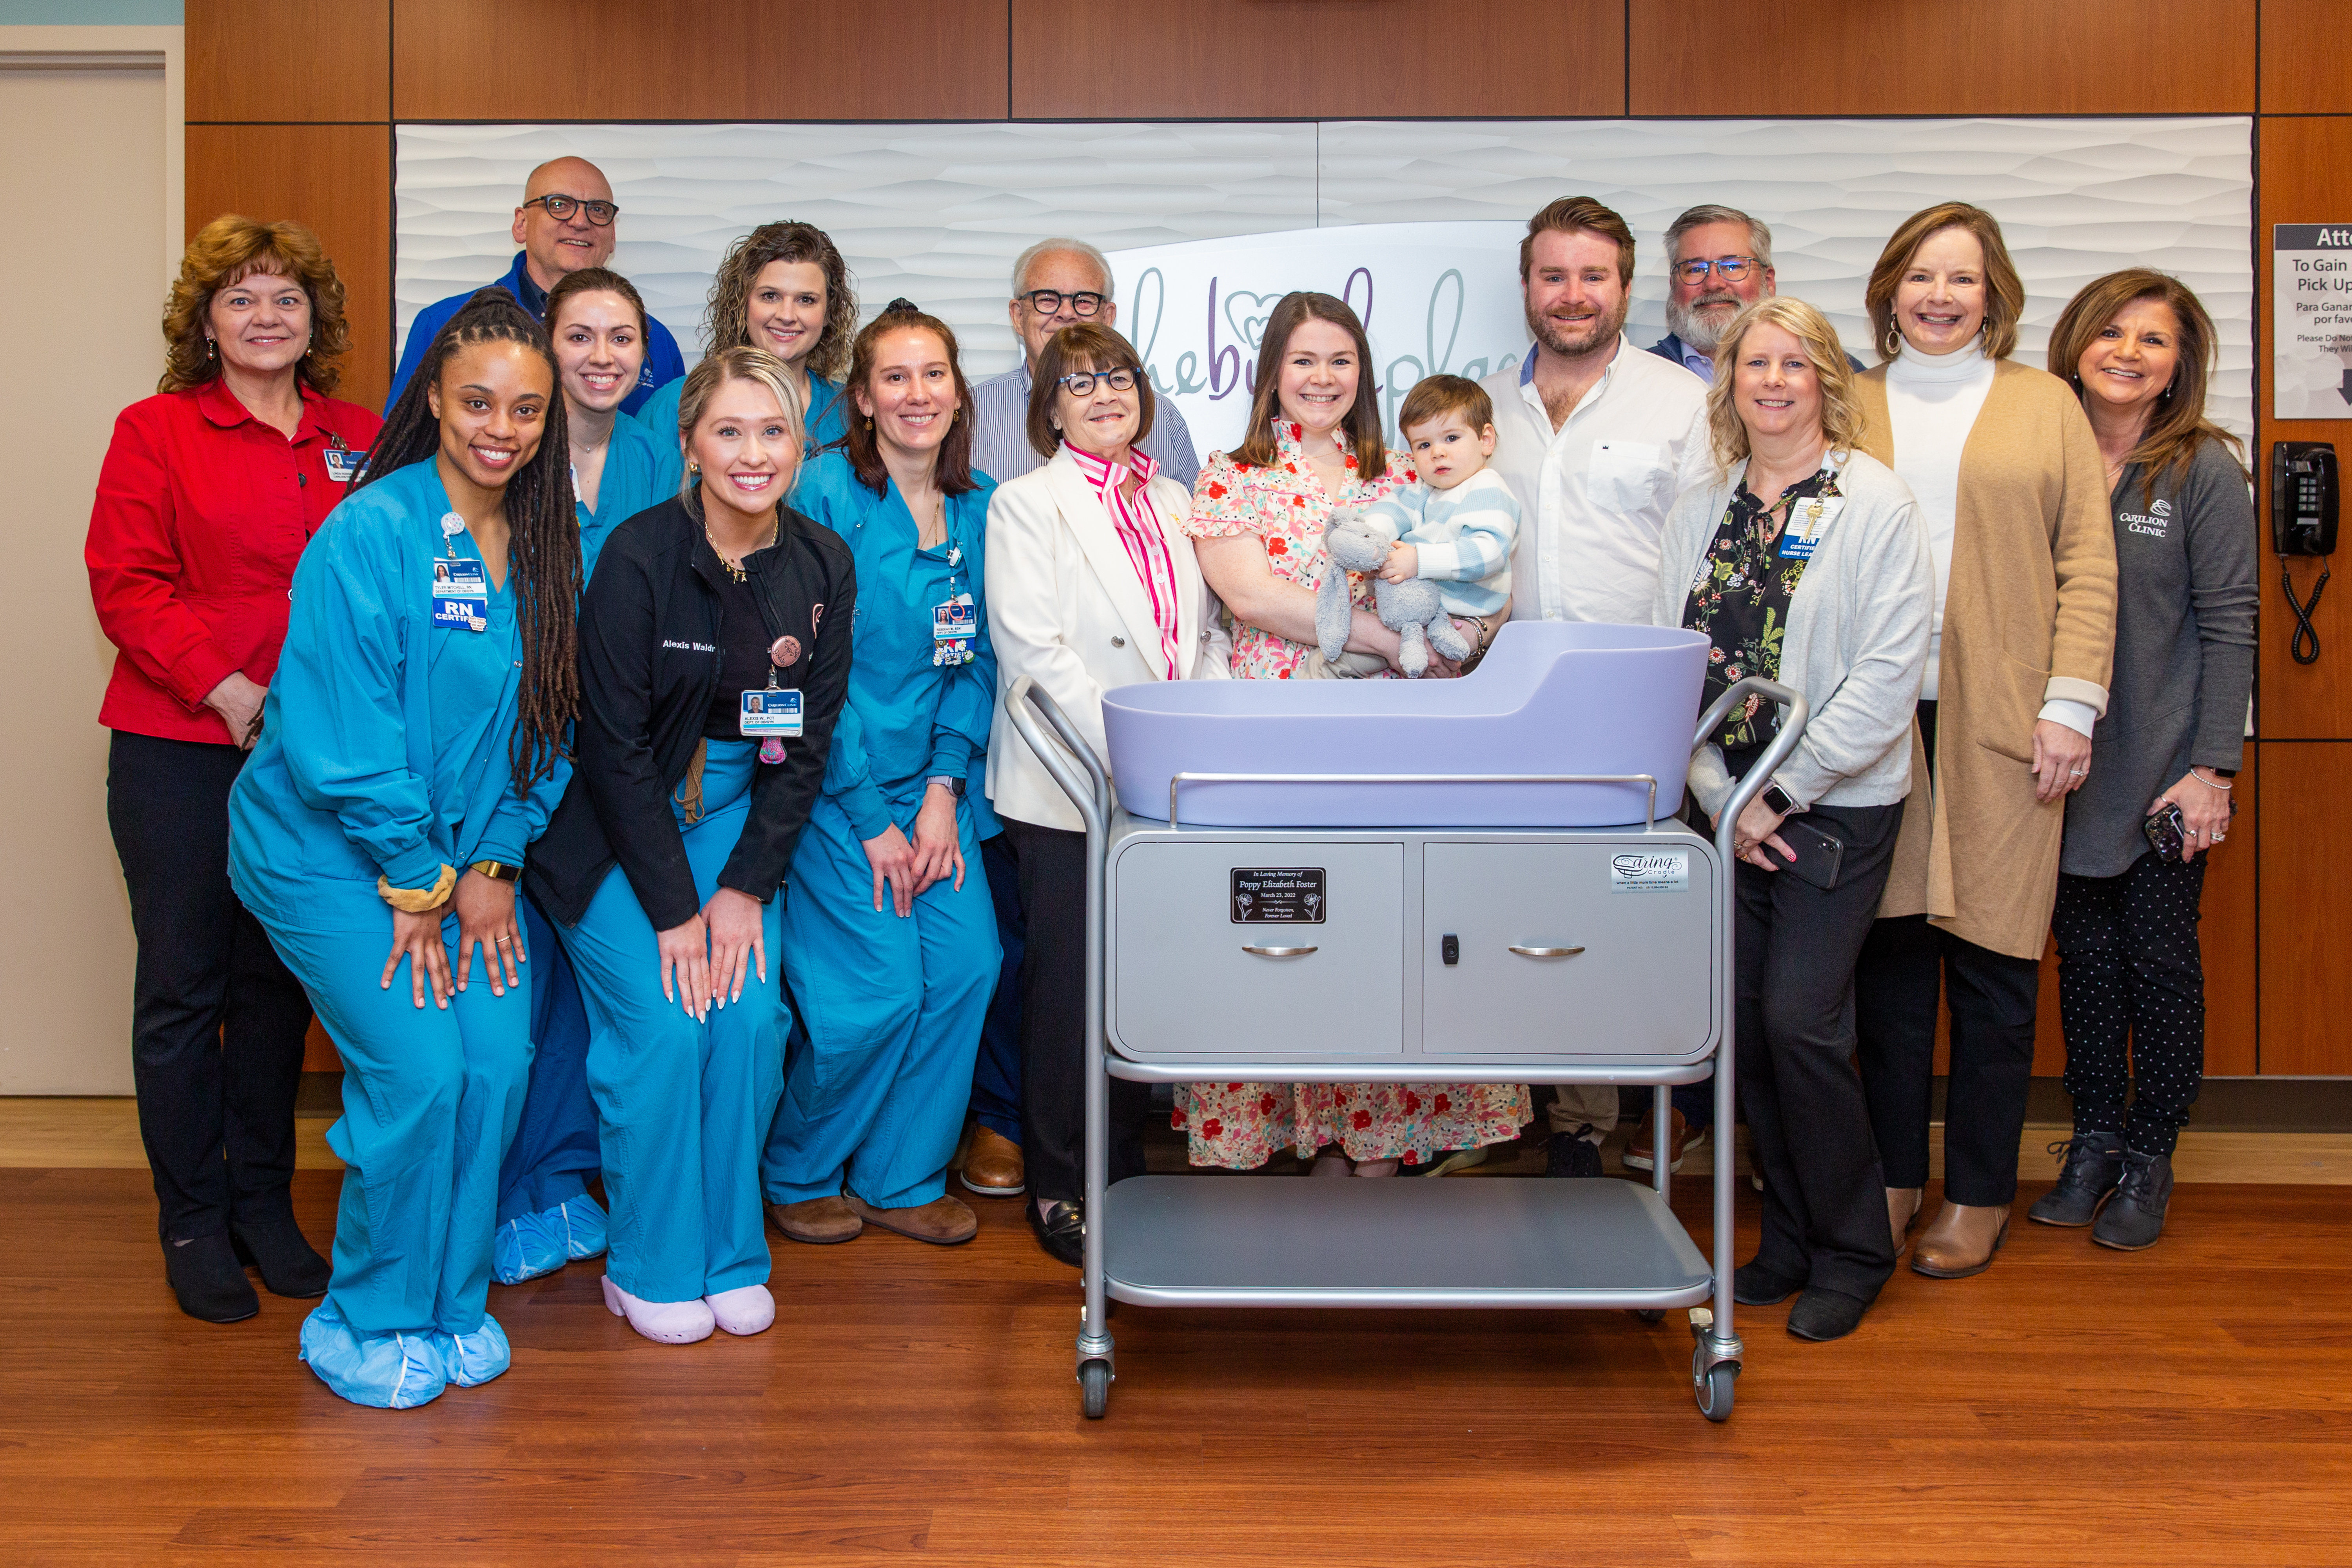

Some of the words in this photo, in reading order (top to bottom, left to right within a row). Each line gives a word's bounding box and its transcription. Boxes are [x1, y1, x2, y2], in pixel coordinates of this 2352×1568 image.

[2316, 229, 2352, 246] Att
[2292, 260, 2309, 271] To
[2314, 259, 2347, 271] Gain
[2298, 278, 2327, 290] Pick
[2334, 278, 2352, 294] Up
[2297, 303, 2318, 311] Para
[2322, 302, 2352, 311] Ganar
[2314, 316, 2332, 326] por
[2319, 345, 2339, 354] They
[2120, 513, 2168, 527] CARILION
[2128, 523, 2166, 537] CLINIC
[445, 601, 473, 616] RN
[435, 613, 468, 622] CERTIF
[662, 640, 690, 649] Alexis
[693, 642, 716, 652] Waldr
[1240, 881, 1261, 891] Poppy
